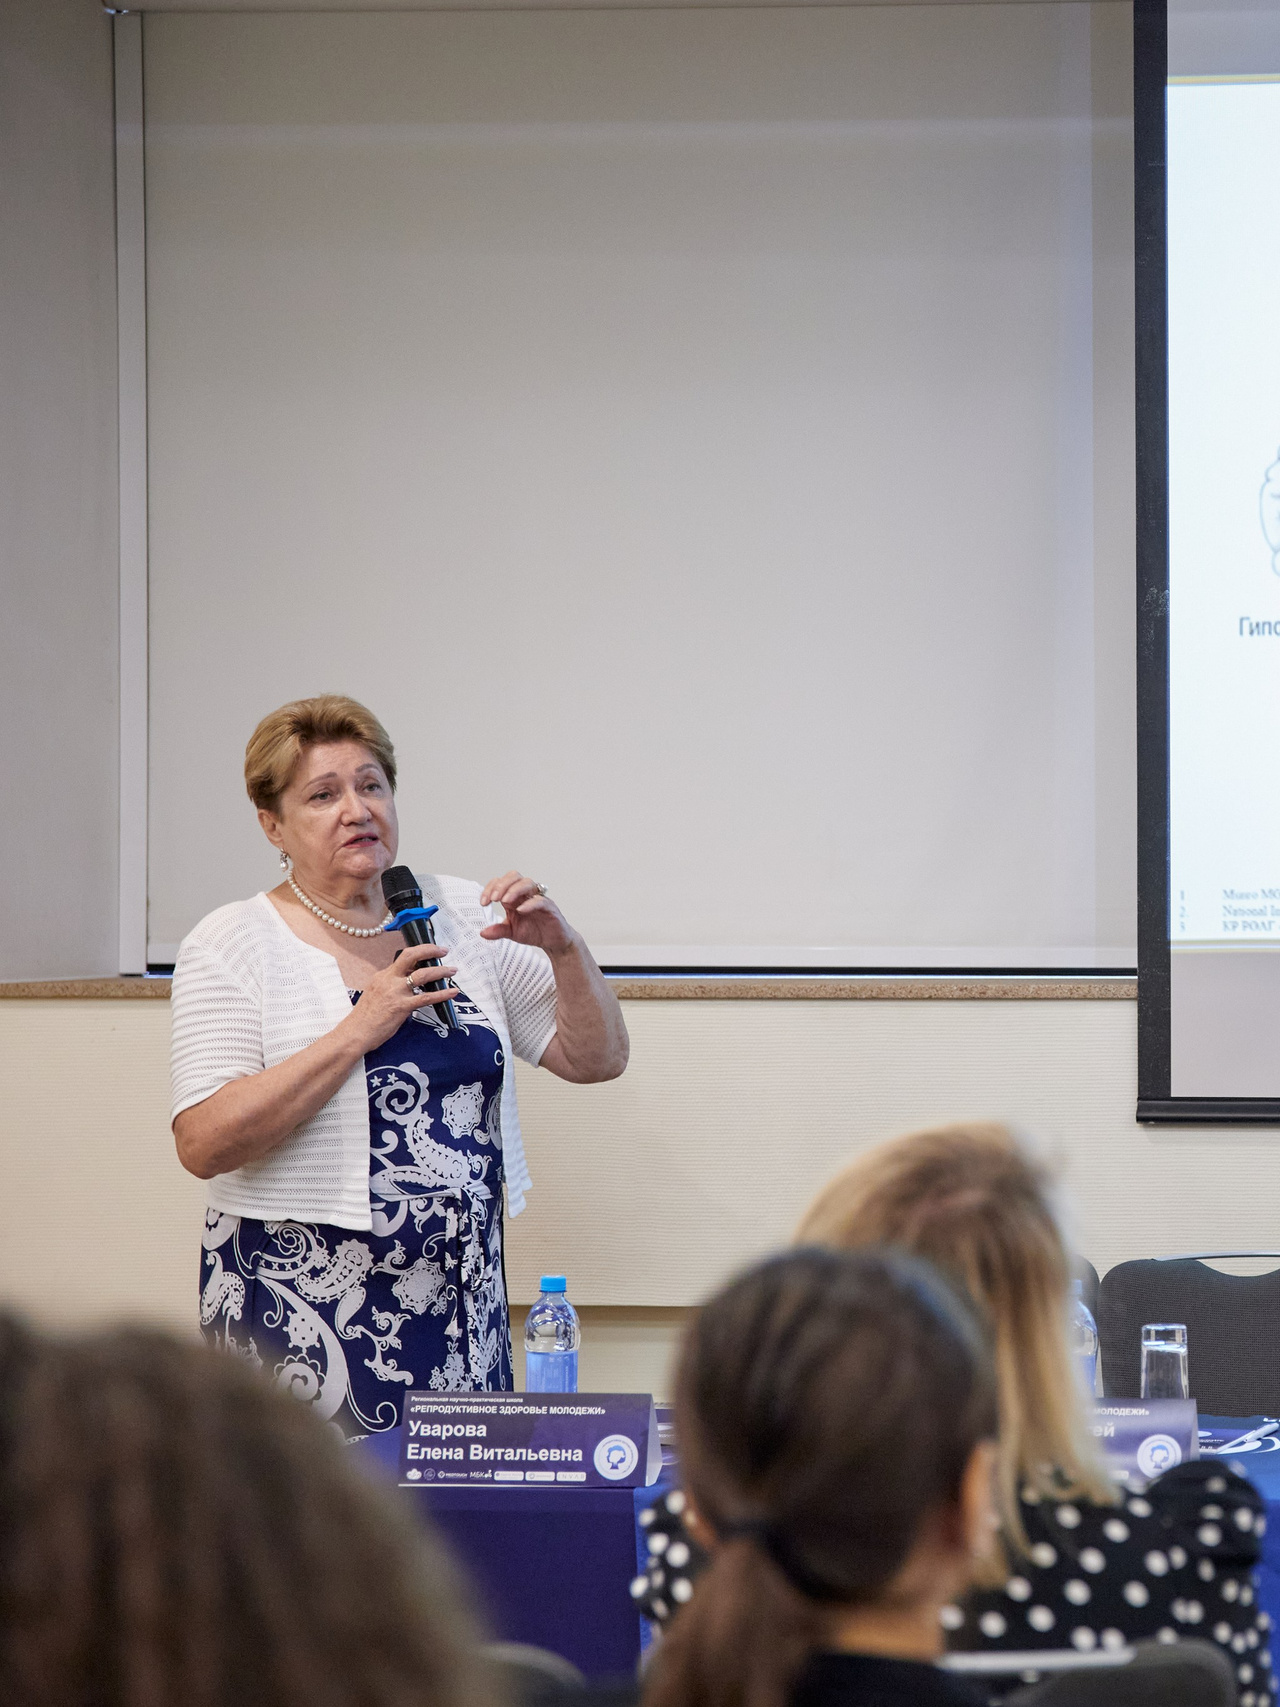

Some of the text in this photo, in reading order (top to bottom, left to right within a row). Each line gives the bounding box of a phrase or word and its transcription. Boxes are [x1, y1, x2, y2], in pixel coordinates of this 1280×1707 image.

[410, 1405, 606, 1416] «РЕПРОДУКТИВНОЕ ЗДОРОВЬЕ МОЛОДЕЖИ»
[409, 1420, 487, 1440] Уварова
[407, 1443, 464, 1460] Елена
[470, 1444, 583, 1461] Витальевна
